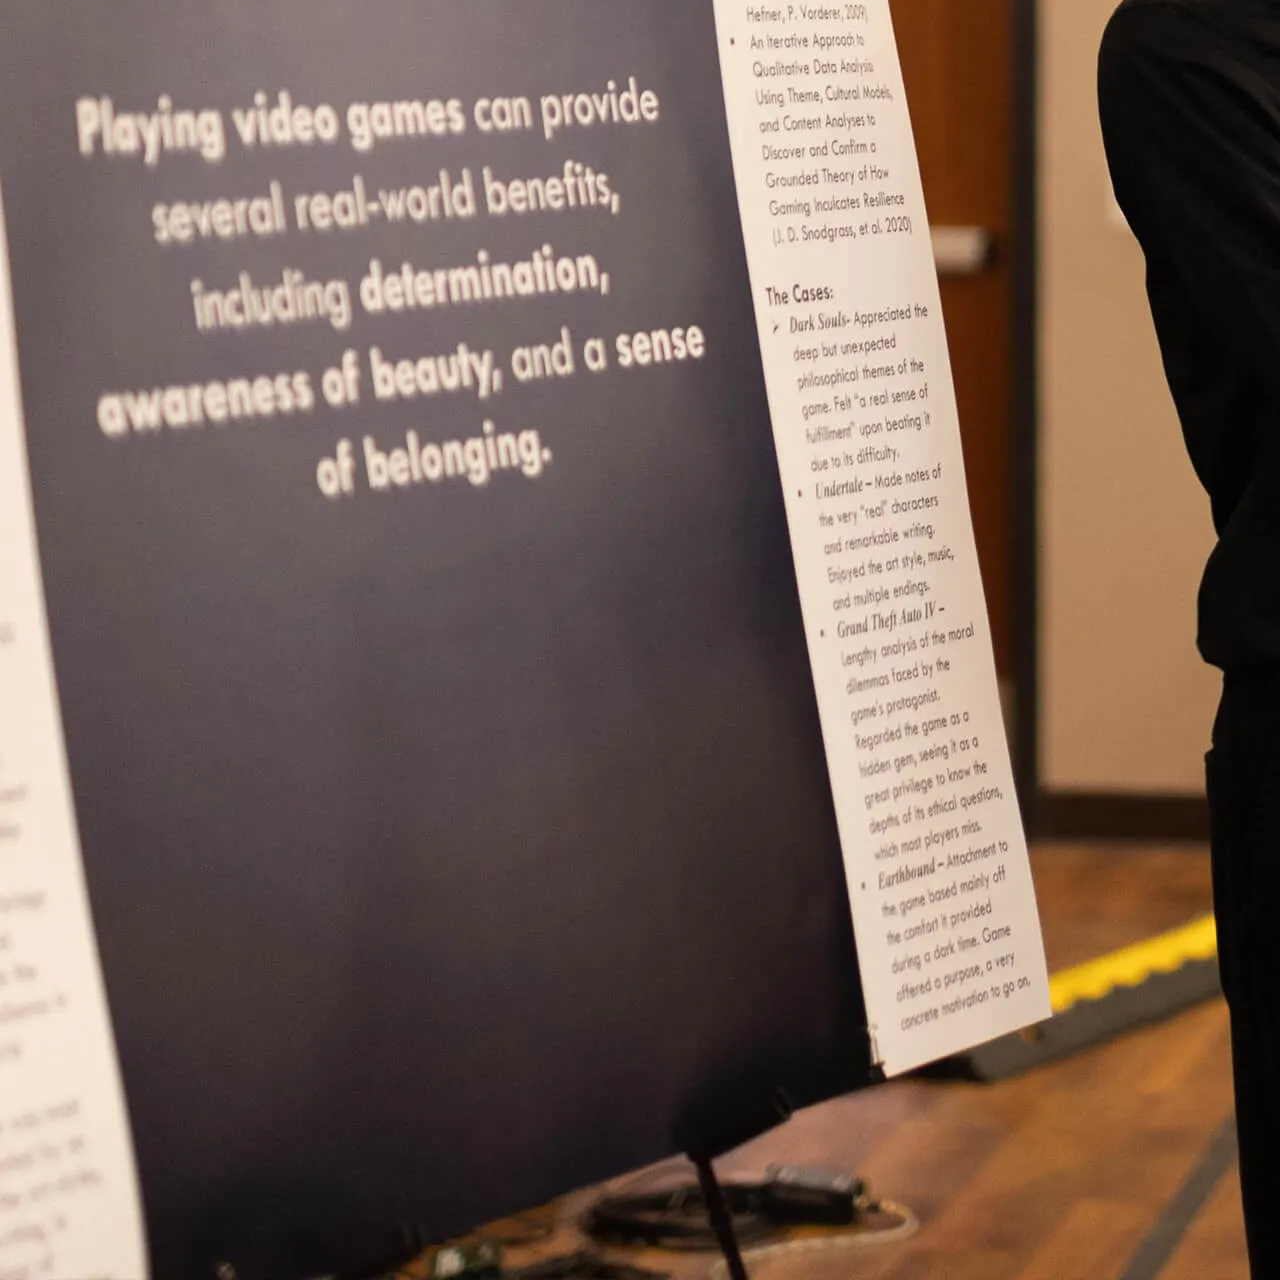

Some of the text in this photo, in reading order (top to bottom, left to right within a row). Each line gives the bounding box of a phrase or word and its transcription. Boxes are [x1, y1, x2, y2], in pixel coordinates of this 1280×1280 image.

[788, 6, 797, 19] P.
[800, 5, 843, 22] Vorderer,
[750, 32, 854, 50] An Iterative Approach
[753, 59, 837, 77] Qualitative Data
[755, 89, 784, 108] Using
[787, 88, 823, 104] Theme,
[825, 86, 860, 100] Cultural
[77, 76, 659, 164] Playing video games can provide
[759, 113, 875, 133] and Content Analyses to
[762, 139, 867, 160] Discover and Confirm
[766, 165, 889, 188] Grounded Theory of How
[152, 159, 619, 245] several real-world benefits,
[769, 192, 904, 216] Gaming Inculcates Resilience
[802, 224, 856, 242] Snodgrass,
[860, 222, 868, 235] et
[886, 216, 912, 234] 2020)
[191, 243, 609, 332] including determination,
[766, 284, 833, 306] The Cases:
[790, 315, 815, 334] Dark
[854, 306, 911, 329] Appreciated
[914, 304, 928, 318] the
[794, 334, 896, 362] deep but unexpected
[98, 322, 704, 439] awareness of beauty, and a sense
[798, 364, 895, 391] philosophical themes
[801, 402, 831, 420] game.
[834, 395, 851, 410] Felt
[870, 391, 888, 406] real
[891, 389, 916, 403] sense
[919, 383, 928, 398] of
[859, 414, 921, 437] upon beating
[317, 421, 552, 497] of belonging.
[815, 462, 941, 499] Undertale Made notes of
[837, 508, 858, 524] very
[891, 495, 938, 514] characters
[824, 522, 935, 555] and remarkable writing.
[828, 548, 954, 584] Enjoyed art style, music,
[854, 585, 889, 607] multiple
[837, 601, 935, 638] Grand Theft Auto IV
[881, 622, 974, 659] analysis moral
[892, 661, 933, 682] faced by
[887, 689, 940, 714] protagonist.
[922, 717, 947, 736] game
[894, 742, 948, 769] gem, seeing
[893, 774, 933, 800] privilege
[947, 765, 970, 781] know
[973, 760, 987, 774] the
[928, 786, 1002, 817] ethical questions,
[901, 820, 982, 853] most players miss.
[878, 842, 996, 889] Earthbound Attachment
[900, 864, 1005, 916] game based mainly off
[904, 898, 992, 940] comfort provided
[892, 925, 1011, 974] during dark time. Game
[897, 951, 1015, 1002] offered purpose, very
[901, 1005, 938, 1030] concrete
[942, 990, 989, 1015] motivation
[1003, 982, 1014, 998] go
